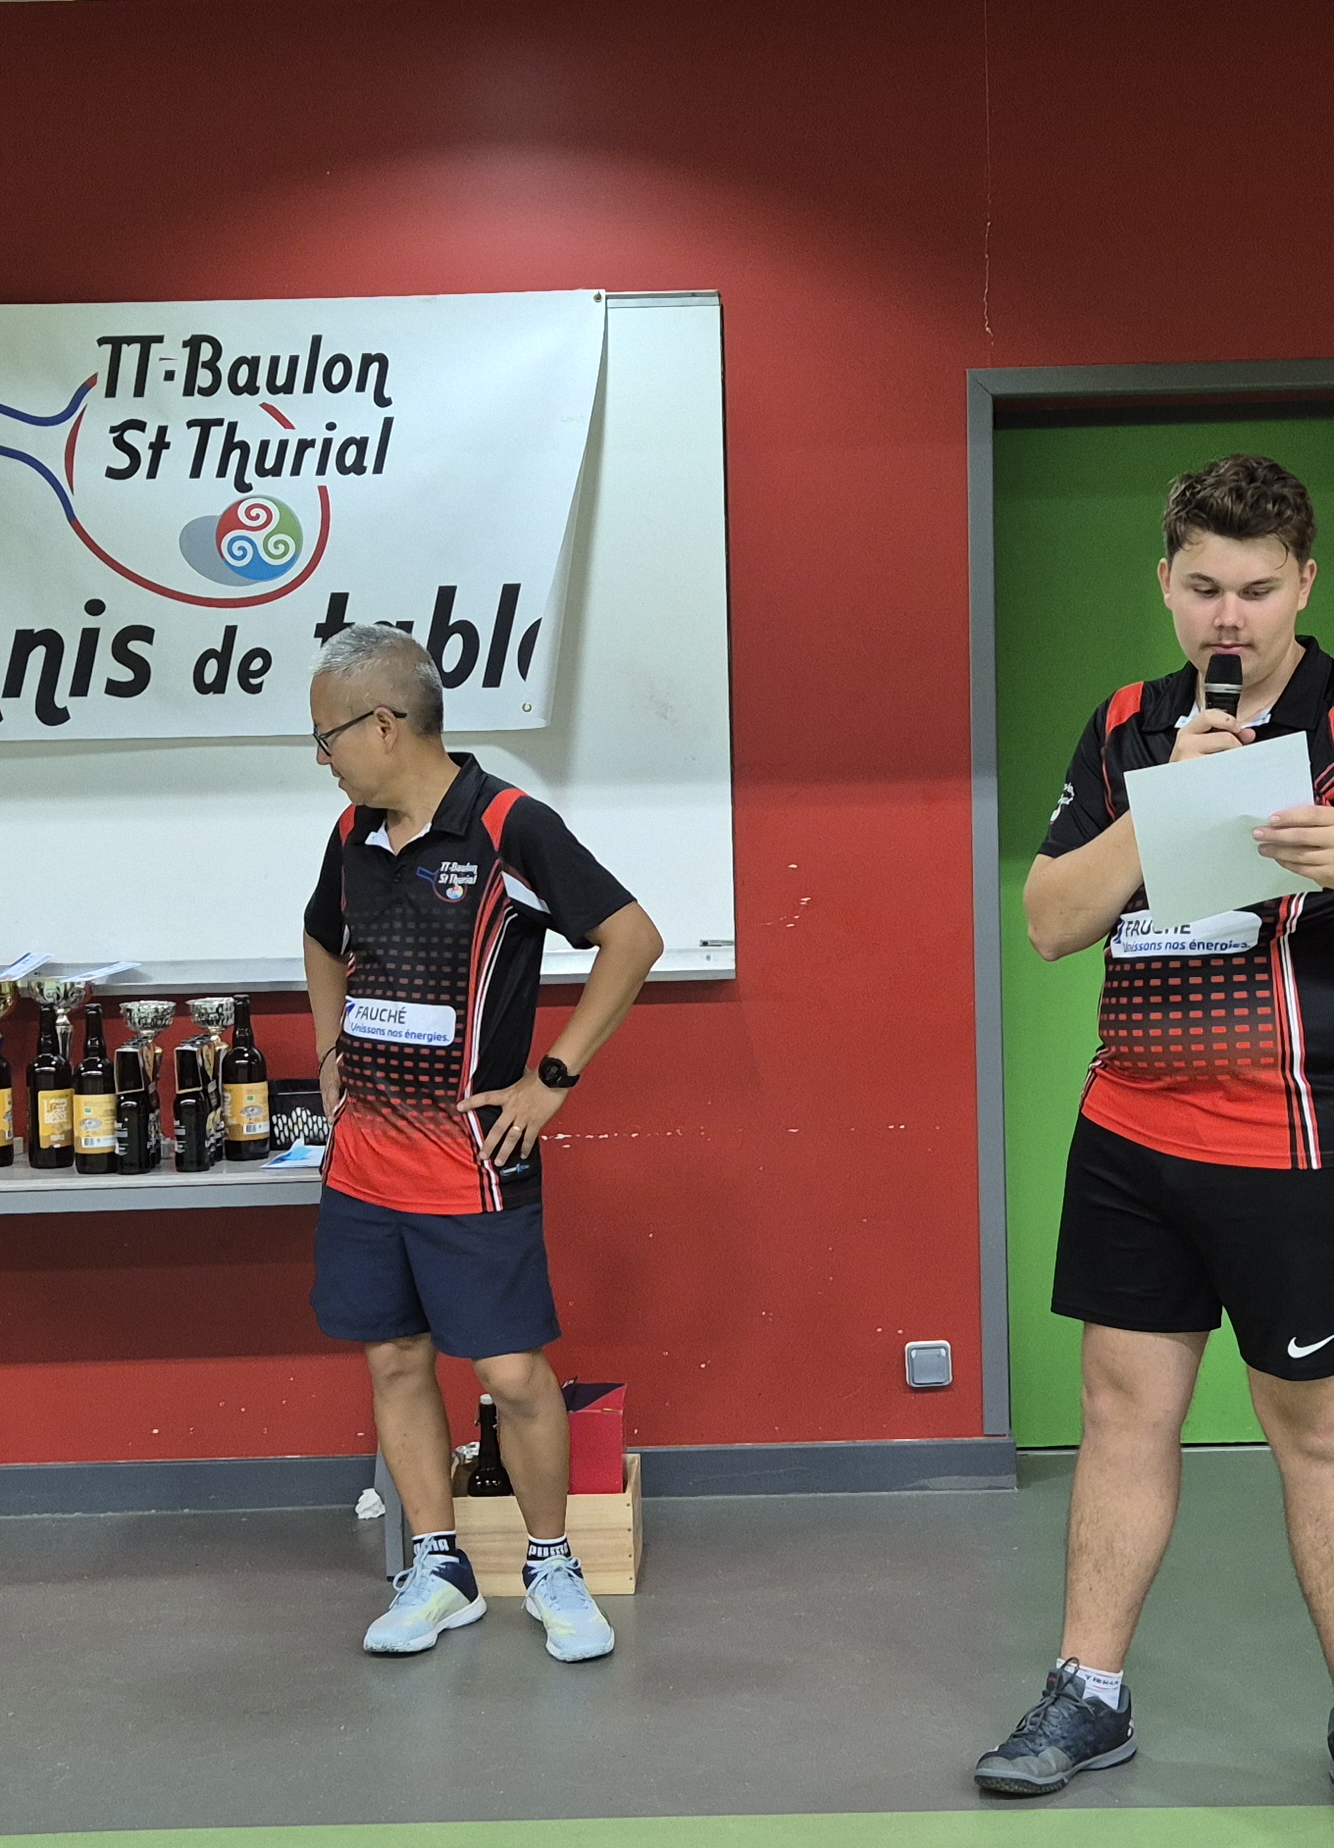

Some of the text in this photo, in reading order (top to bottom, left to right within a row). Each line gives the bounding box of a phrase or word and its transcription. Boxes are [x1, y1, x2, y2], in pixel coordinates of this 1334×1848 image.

[104, 416, 395, 493] St Thurial
[193, 624, 273, 696] de
[313, 583, 543, 689] tbl
[1164, 940, 1186, 951] nos
[355, 1006, 407, 1025] FAUCHÉ
[350, 1022, 386, 1036] Unissons
[387, 1029, 403, 1038] nos
